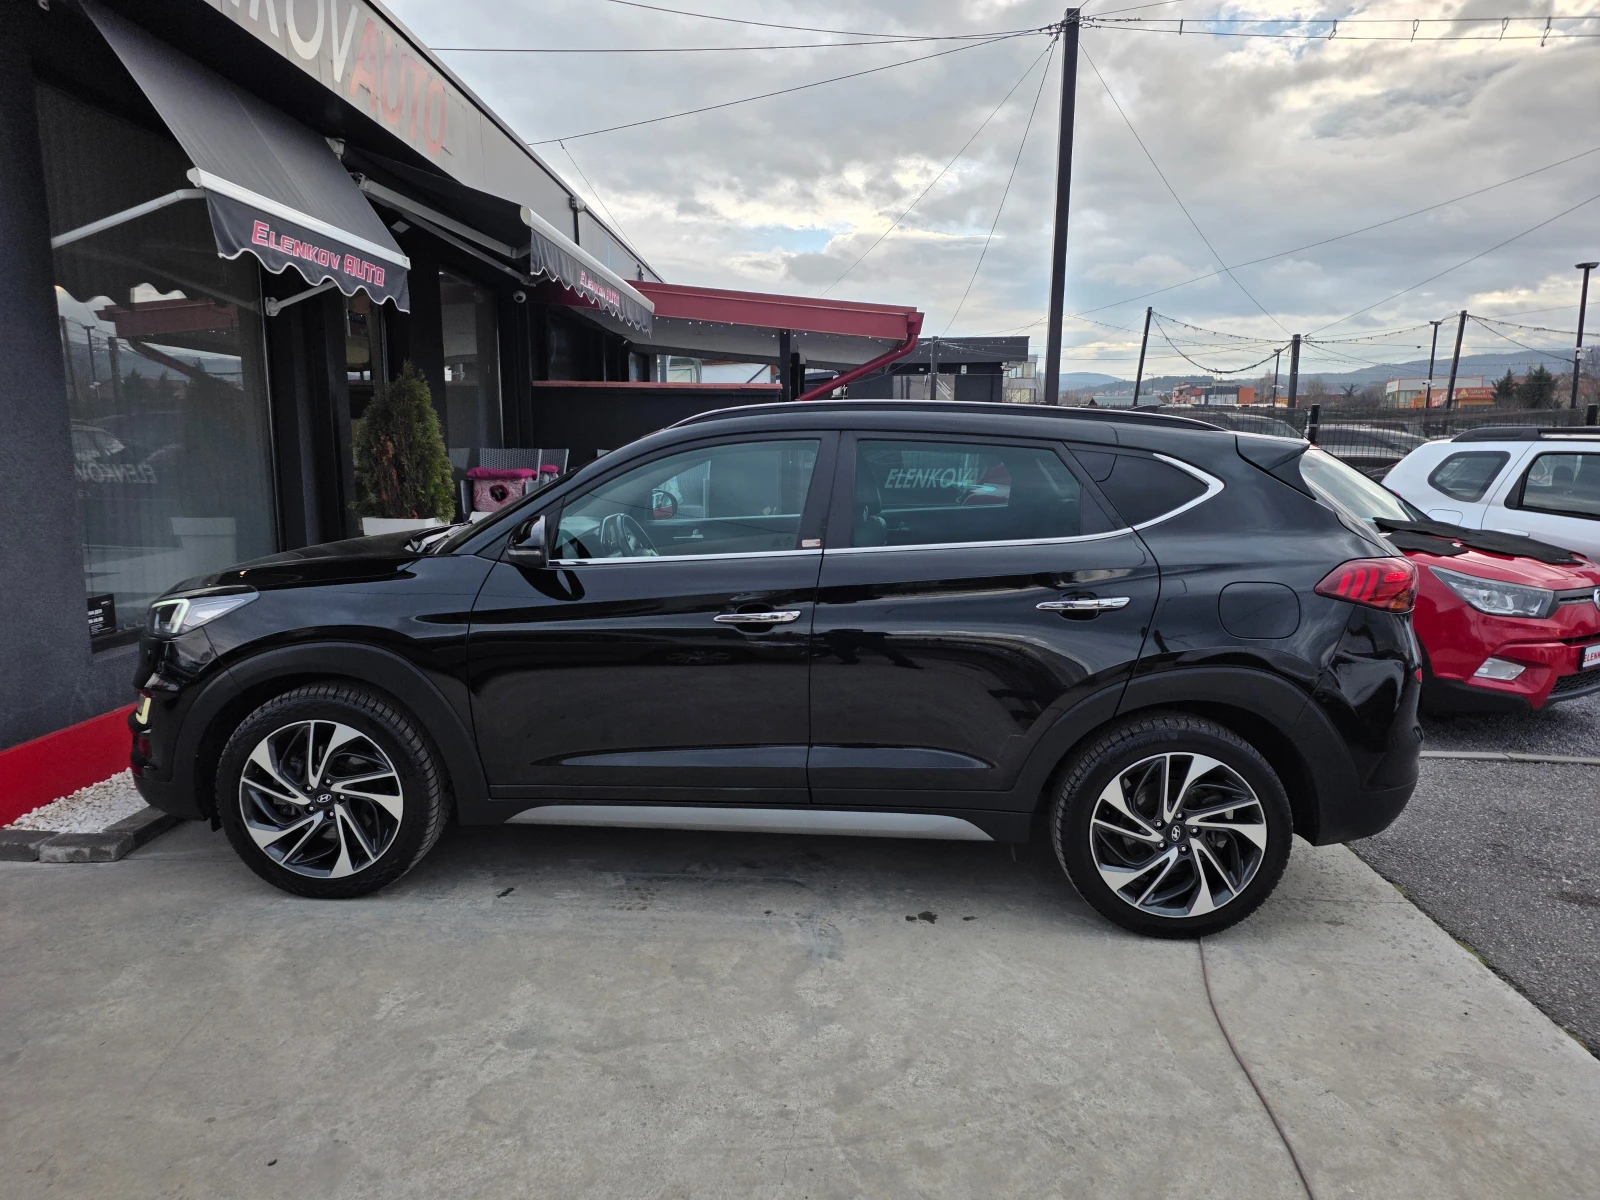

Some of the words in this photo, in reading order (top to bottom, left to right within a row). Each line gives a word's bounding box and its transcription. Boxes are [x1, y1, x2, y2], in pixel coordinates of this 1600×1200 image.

[229, 0, 358, 83] OV
[350, 17, 446, 156] AUTO
[251, 219, 341, 270] ELENKOV
[343, 254, 385, 287] AUTO
